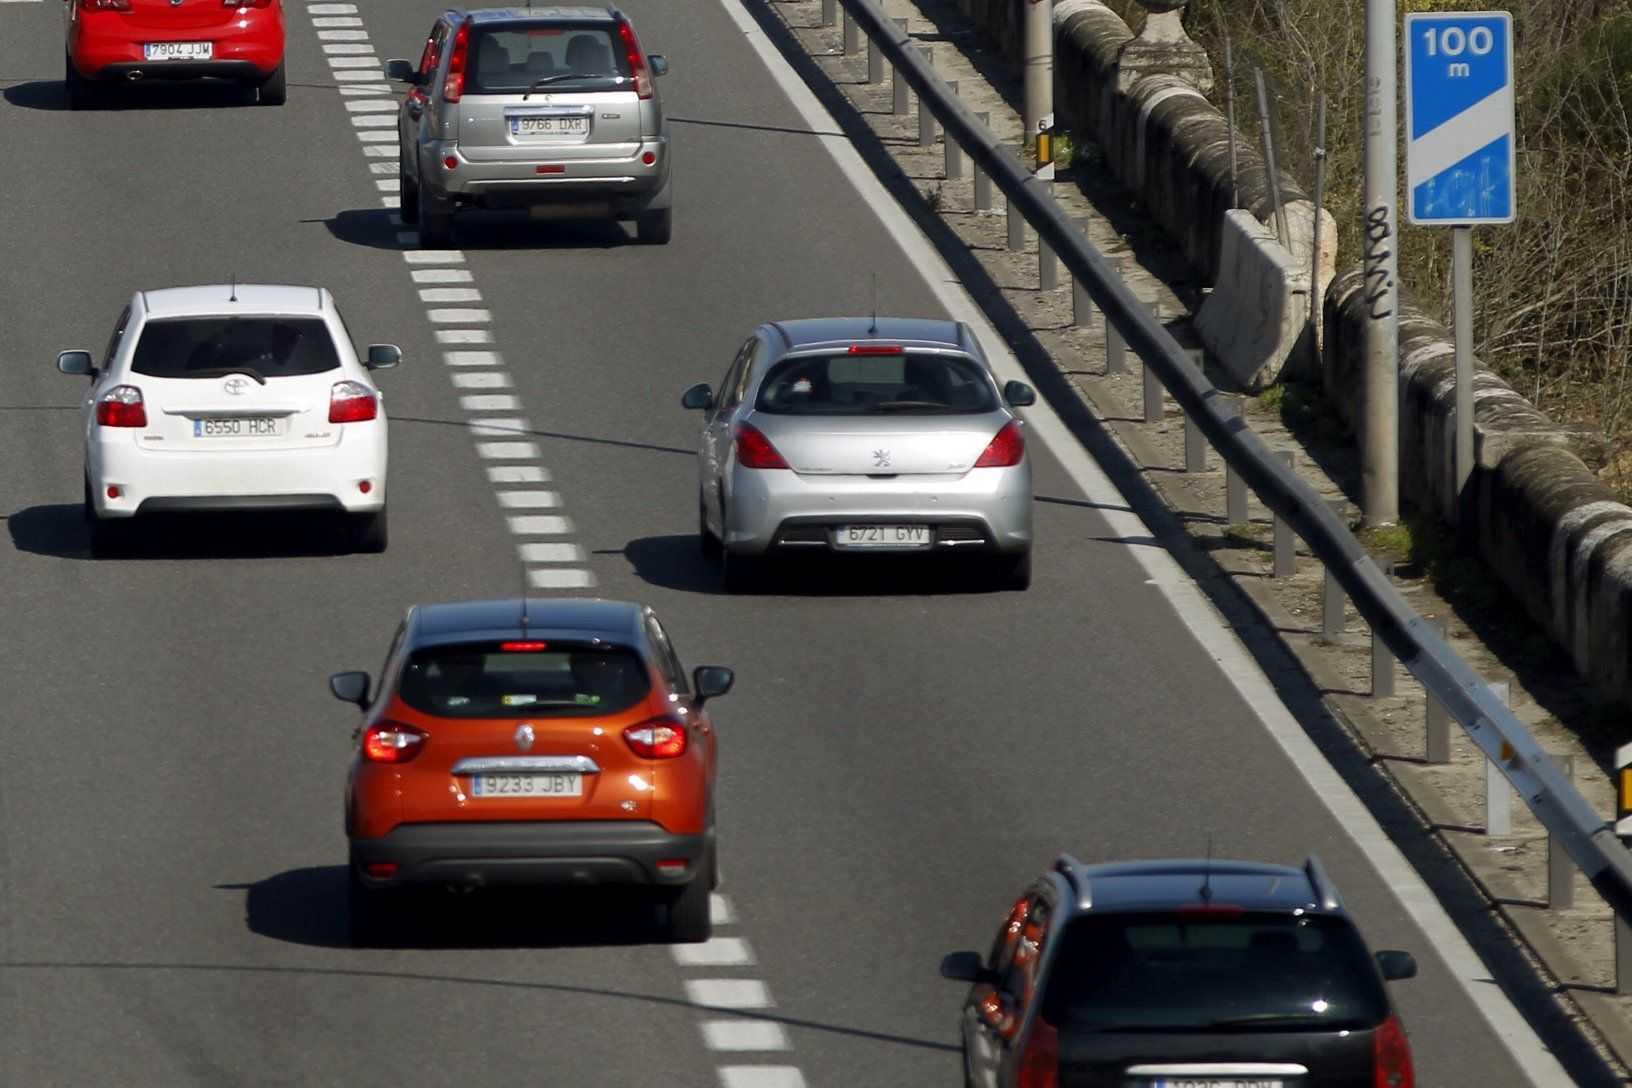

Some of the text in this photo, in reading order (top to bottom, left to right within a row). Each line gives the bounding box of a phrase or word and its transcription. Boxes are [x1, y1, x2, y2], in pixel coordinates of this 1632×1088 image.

[1423, 26, 1493, 56] 100
[152, 44, 183, 56] 7904
[1448, 62, 1470, 78] m
[206, 419, 277, 434] 6550 HCR
[849, 527, 924, 541] 6721 GYV
[487, 775, 577, 794] 9233 JBY
